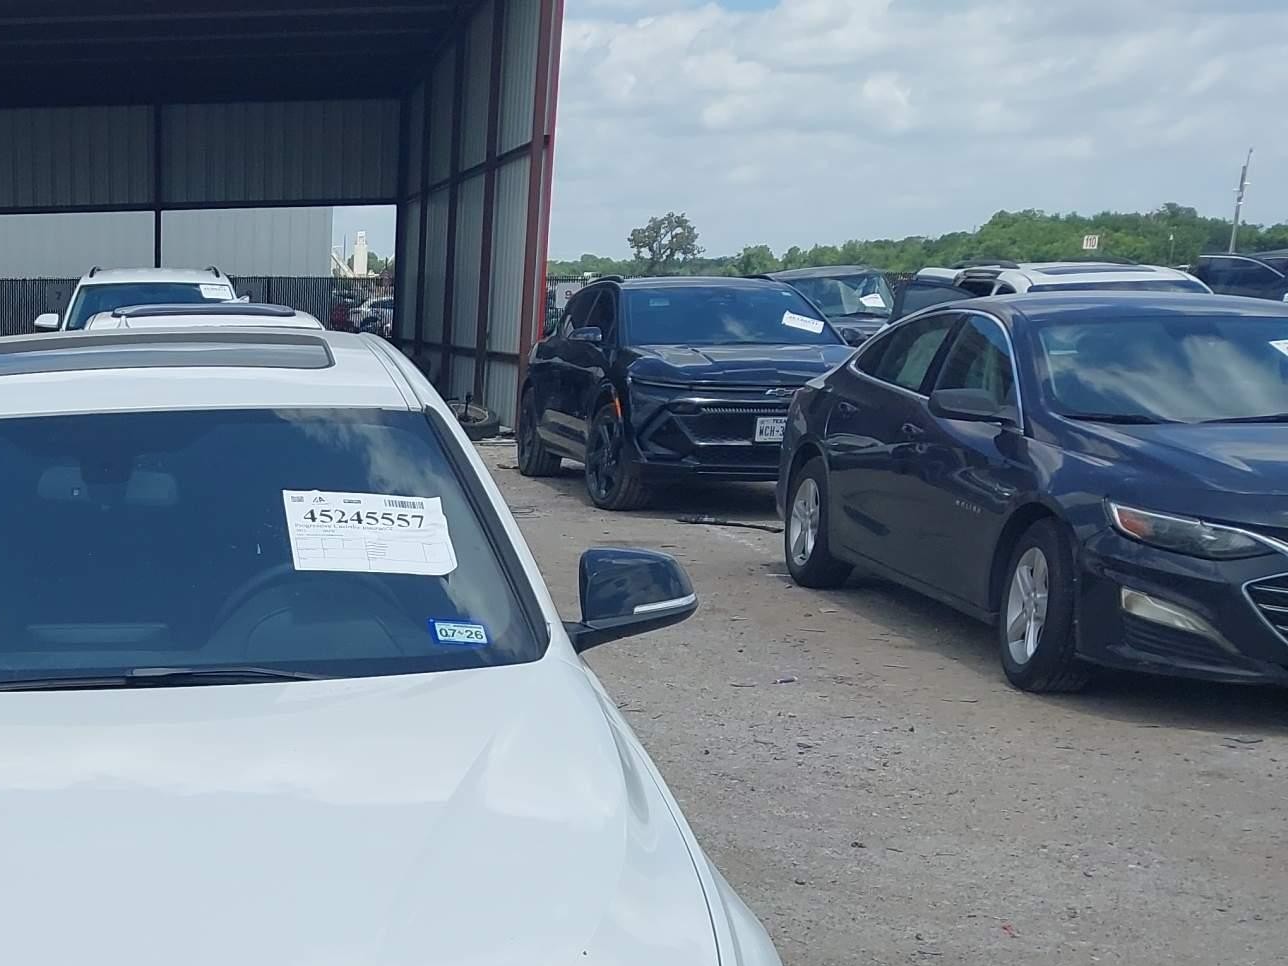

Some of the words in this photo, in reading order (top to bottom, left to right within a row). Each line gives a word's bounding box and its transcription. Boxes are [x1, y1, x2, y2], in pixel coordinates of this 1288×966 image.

[1085, 236, 1097, 248] 110
[55, 291, 62, 301] 7
[564, 290, 573, 299] 9
[759, 425, 785, 437] WCH-3
[303, 508, 425, 529] 45245557
[439, 627, 457, 638] 07
[465, 629, 484, 640] 26
